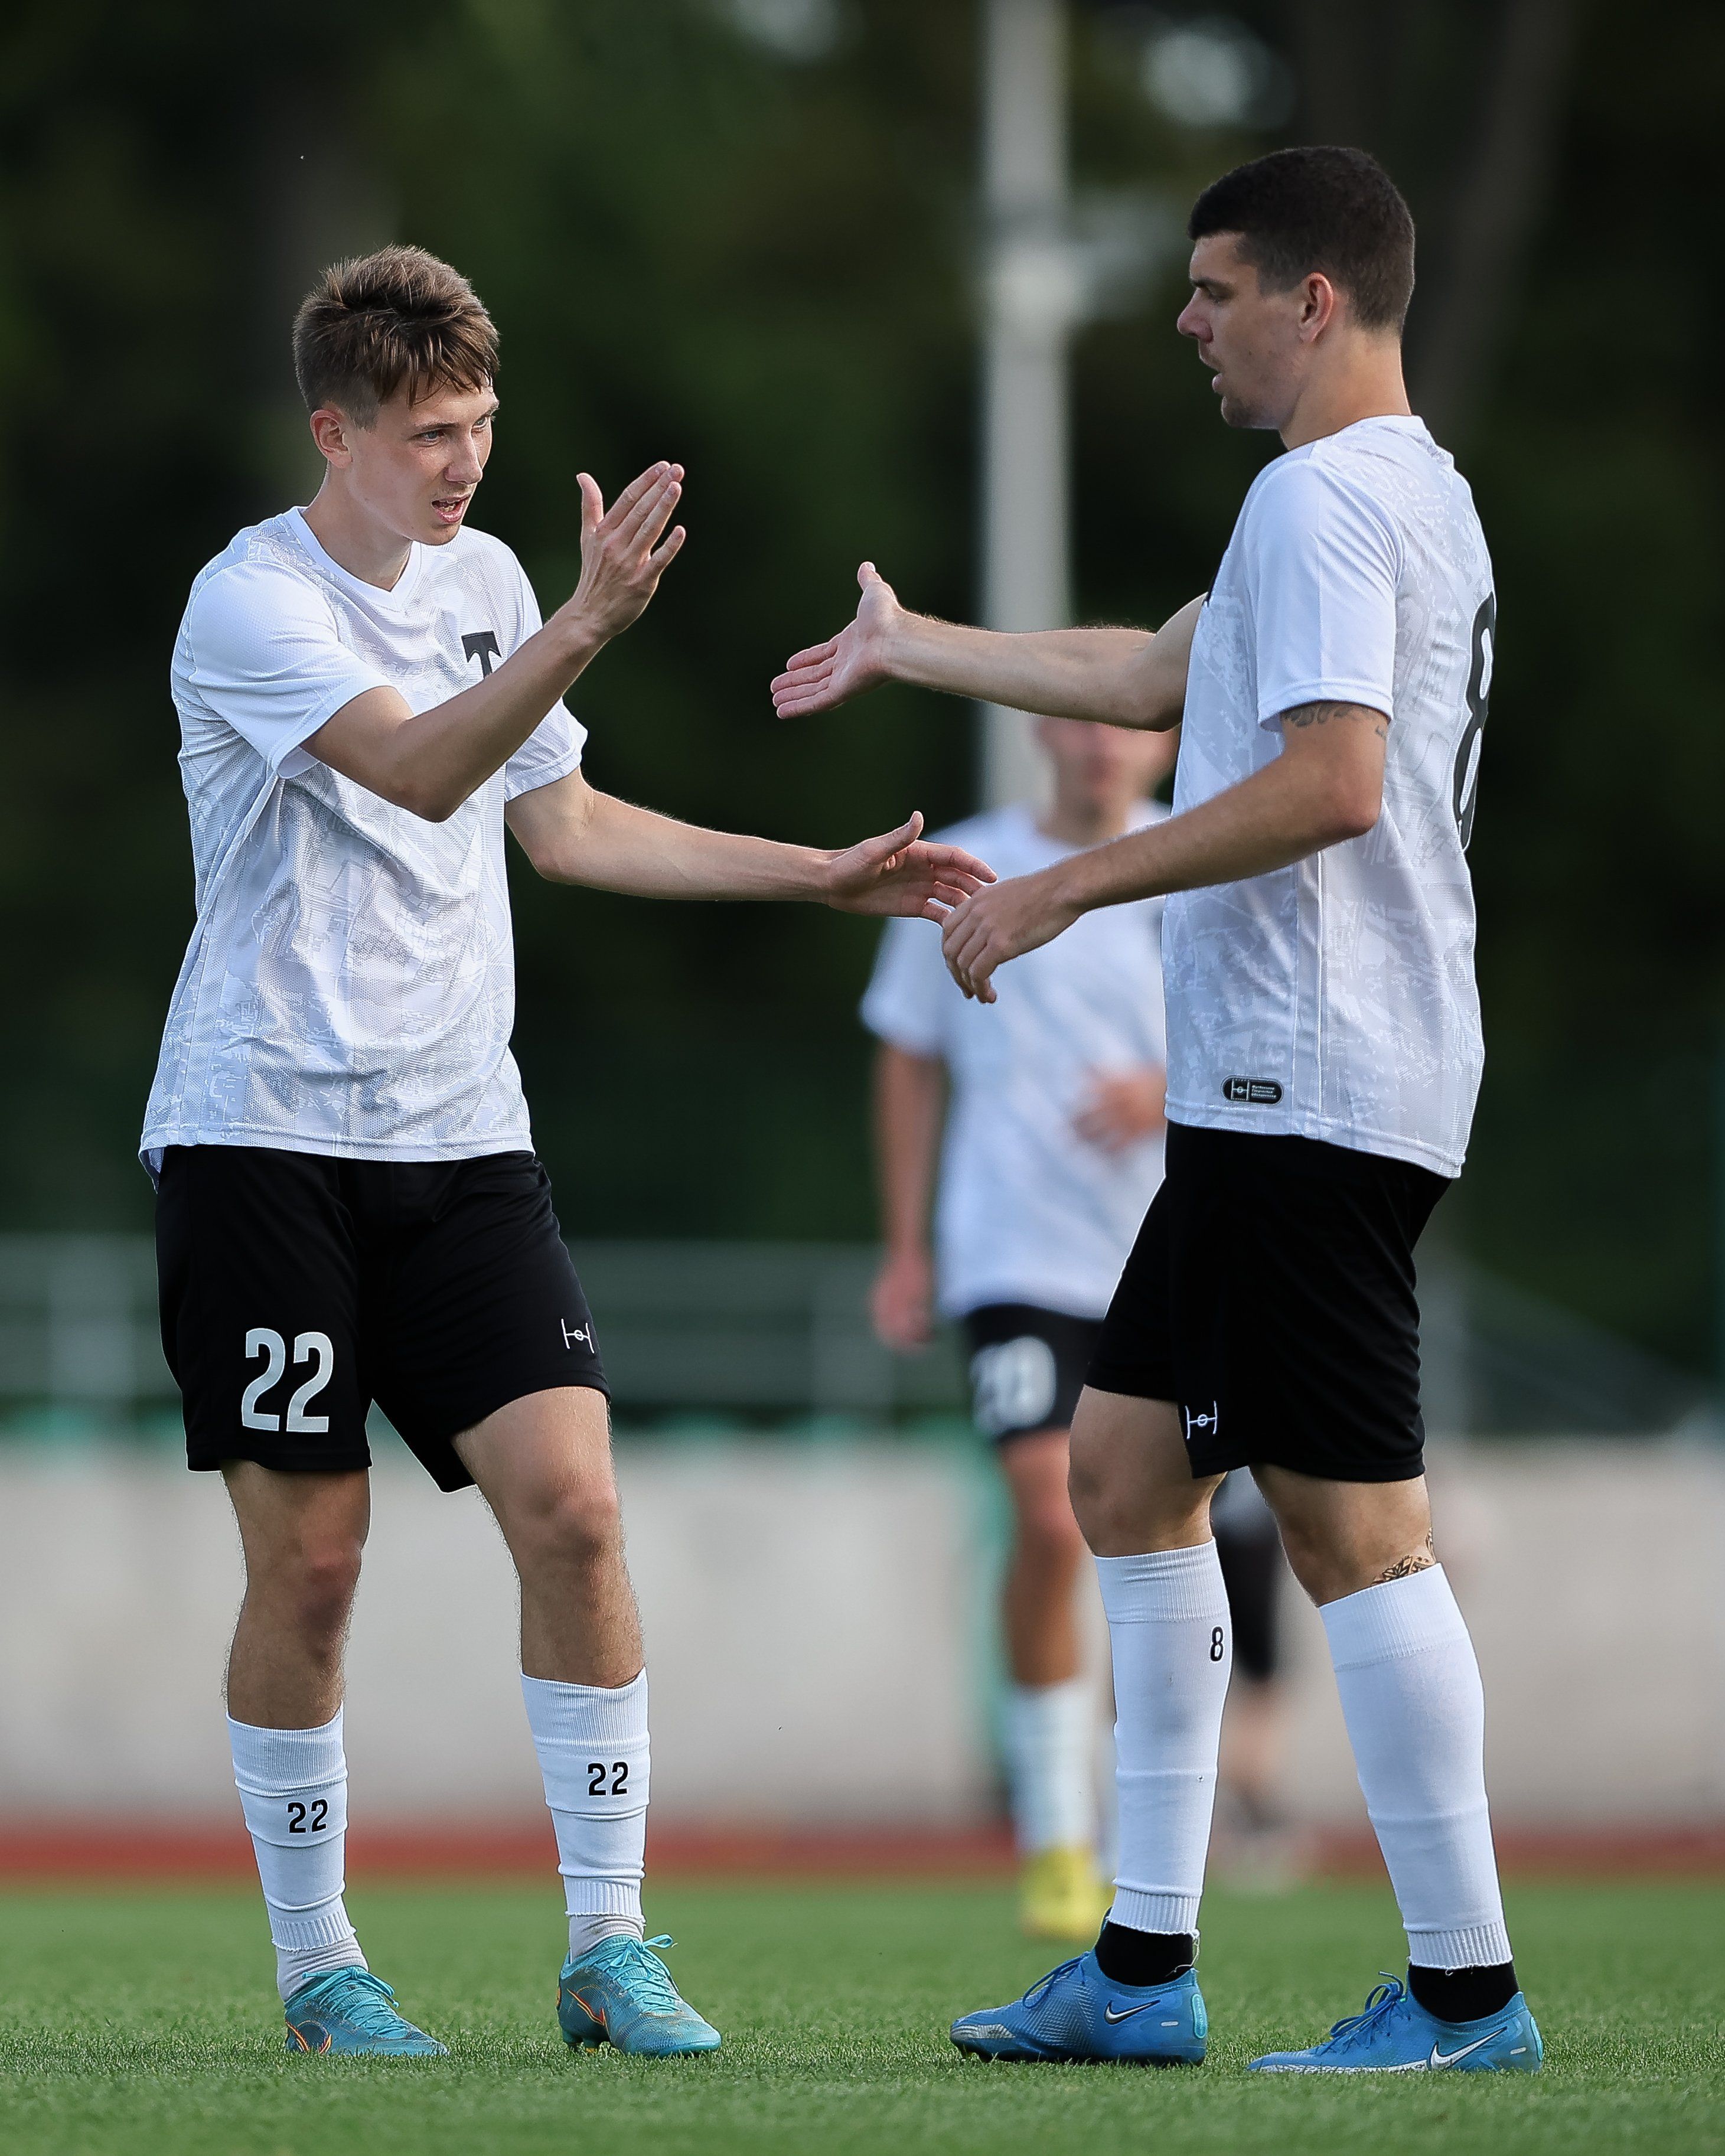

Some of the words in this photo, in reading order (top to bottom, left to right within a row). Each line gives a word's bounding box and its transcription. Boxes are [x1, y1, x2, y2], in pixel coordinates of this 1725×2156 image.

[461, 630, 502, 680] T
[1452, 589, 1496, 850] 8
[242, 1327, 334, 1433] 22
[1211, 1626, 1224, 1662] 8
[587, 1762, 628, 1796] 22
[287, 1799, 328, 1833] 22
